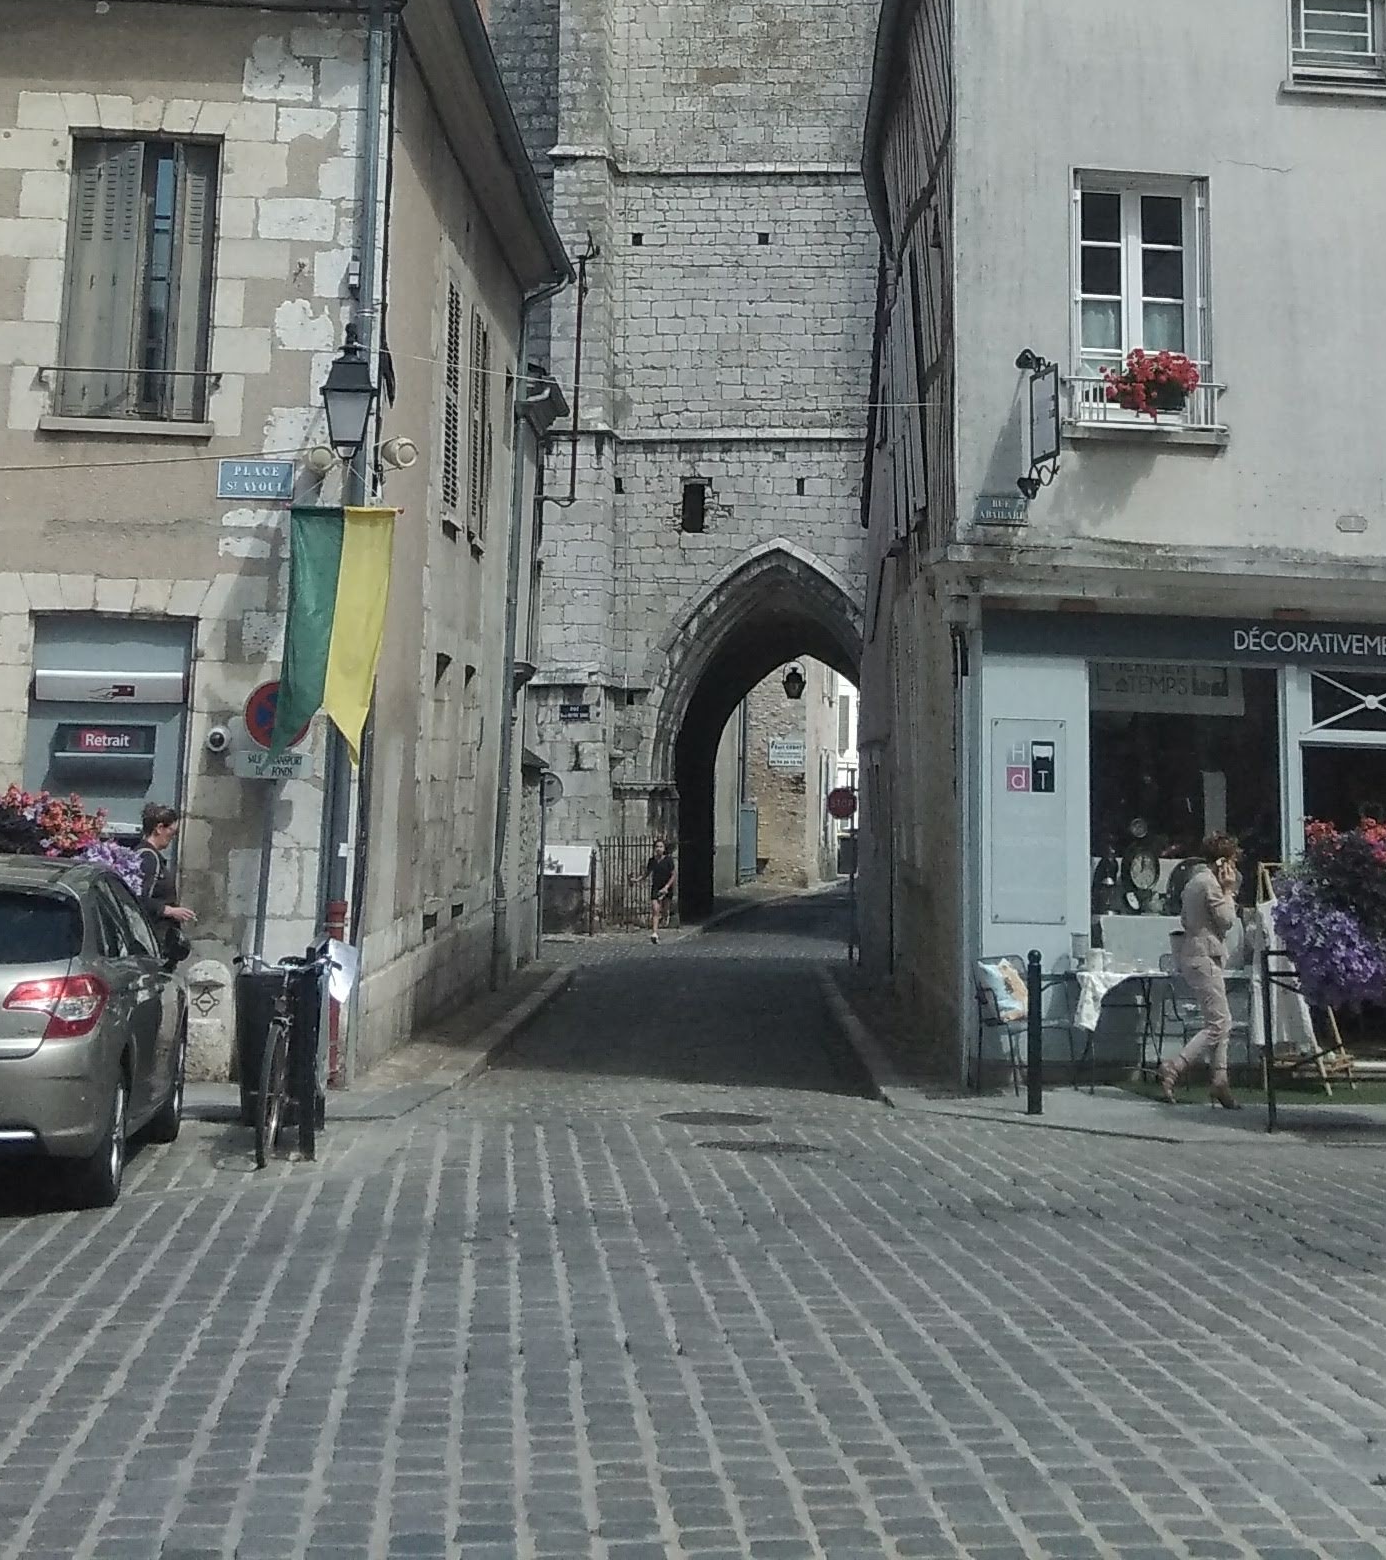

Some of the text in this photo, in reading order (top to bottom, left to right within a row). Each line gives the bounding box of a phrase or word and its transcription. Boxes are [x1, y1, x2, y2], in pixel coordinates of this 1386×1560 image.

[233, 465, 280, 477] PLACE
[85, 733, 131, 747] Retrait
[1012, 743, 1025, 761] H
[271, 766, 293, 776] FONDS
